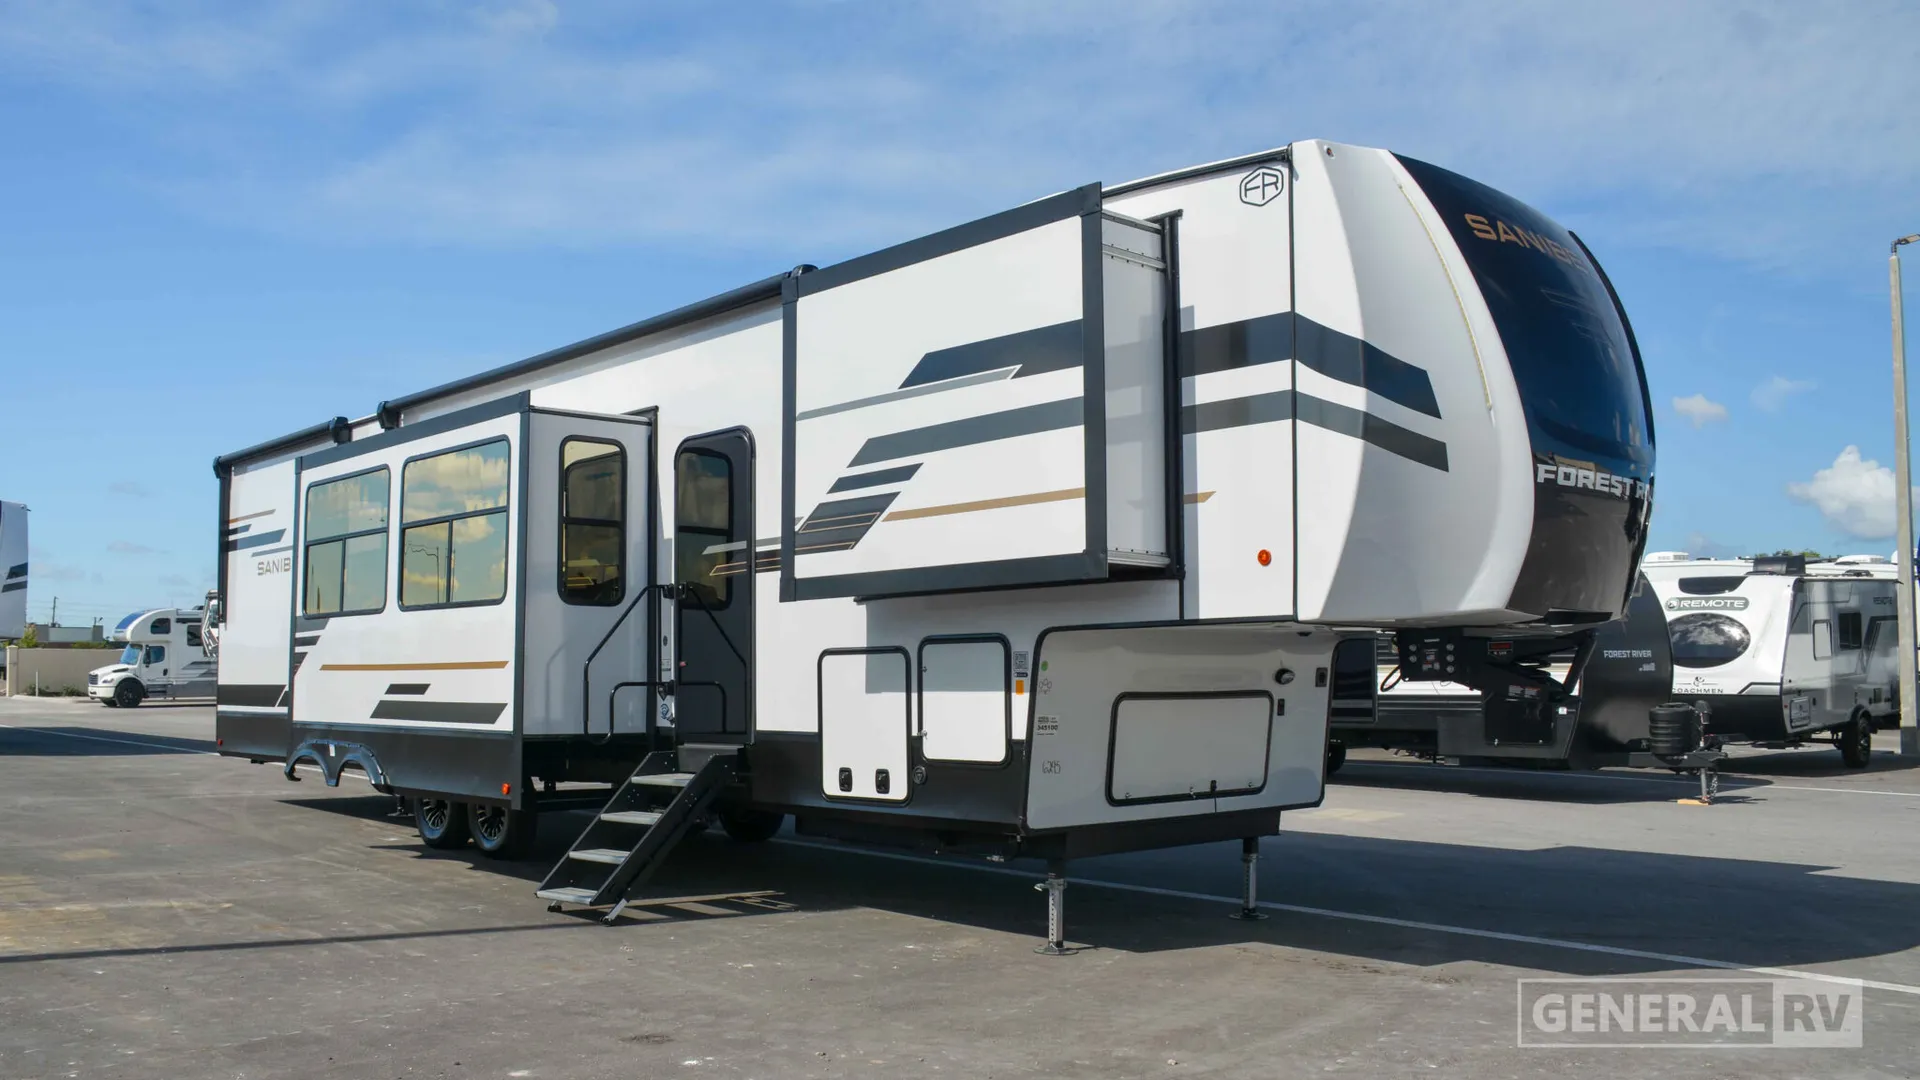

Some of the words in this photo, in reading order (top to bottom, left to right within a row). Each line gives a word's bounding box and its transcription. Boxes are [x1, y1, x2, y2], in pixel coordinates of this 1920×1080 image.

[1536, 463, 1633, 499] FOREST
[257, 557, 291, 576] SANIB
[1680, 599, 1745, 608] REMOTE
[1603, 650, 1630, 658] FOREST
[1631, 649, 1652, 658] RIVER
